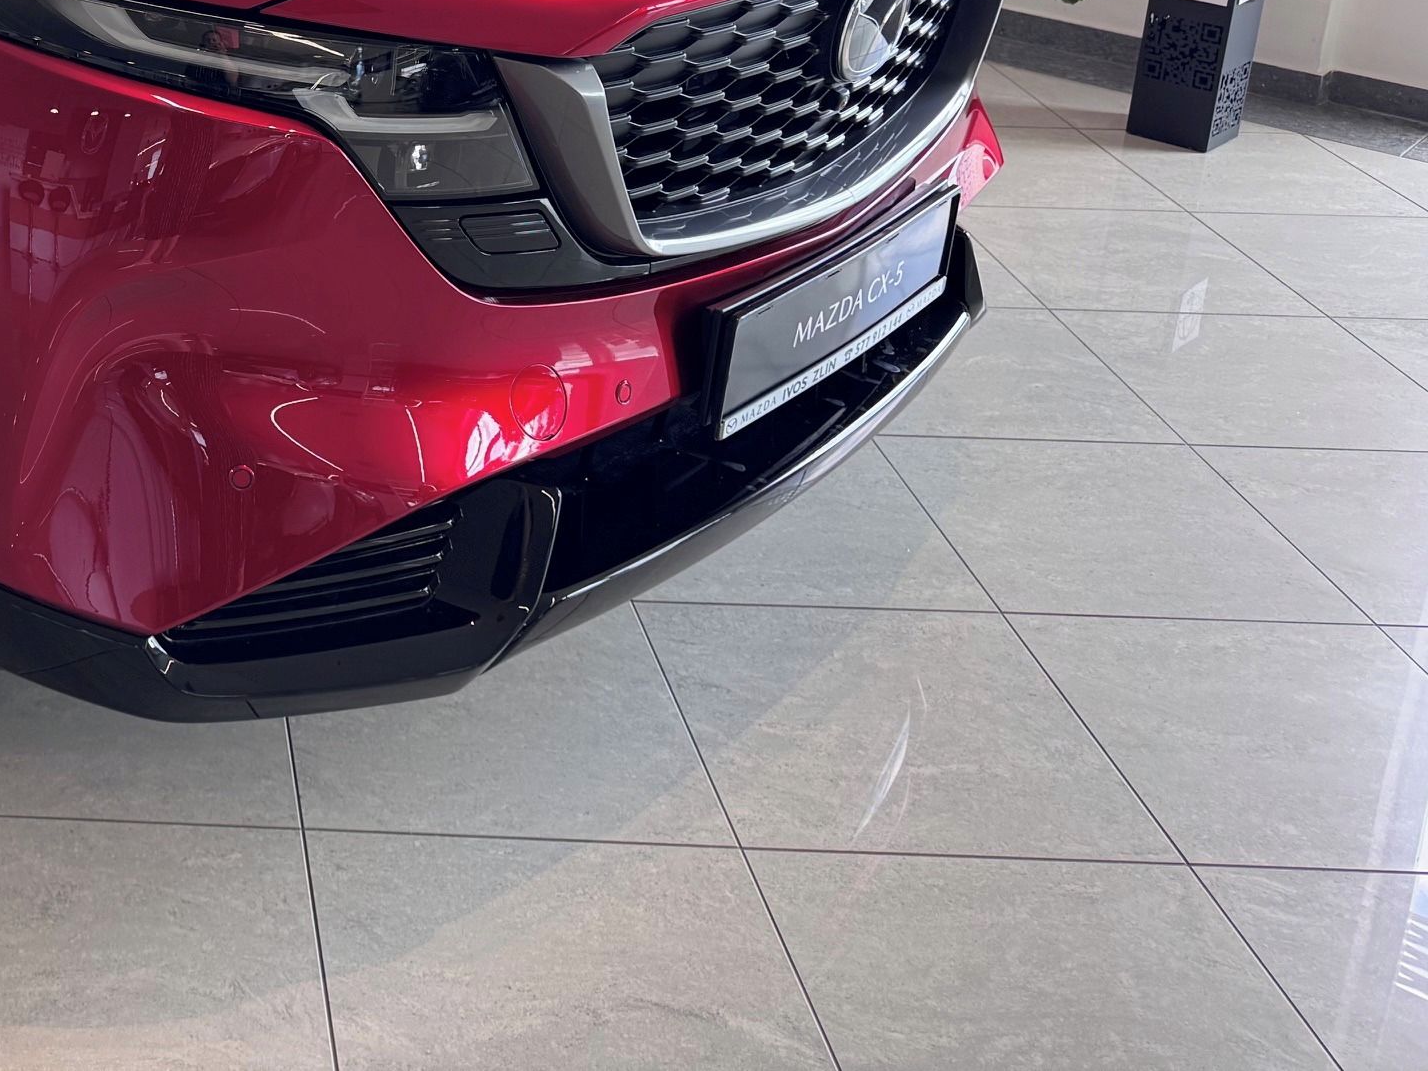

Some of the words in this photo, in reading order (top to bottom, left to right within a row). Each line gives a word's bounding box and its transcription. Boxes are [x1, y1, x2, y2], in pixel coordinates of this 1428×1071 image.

[793, 288, 863, 349] MAZDA
[868, 260, 905, 304] CX-5
[740, 396, 777, 425] MAZDA
[782, 376, 808, 402] IVOS
[855, 336, 871, 355] 577
[872, 324, 887, 344] 912
